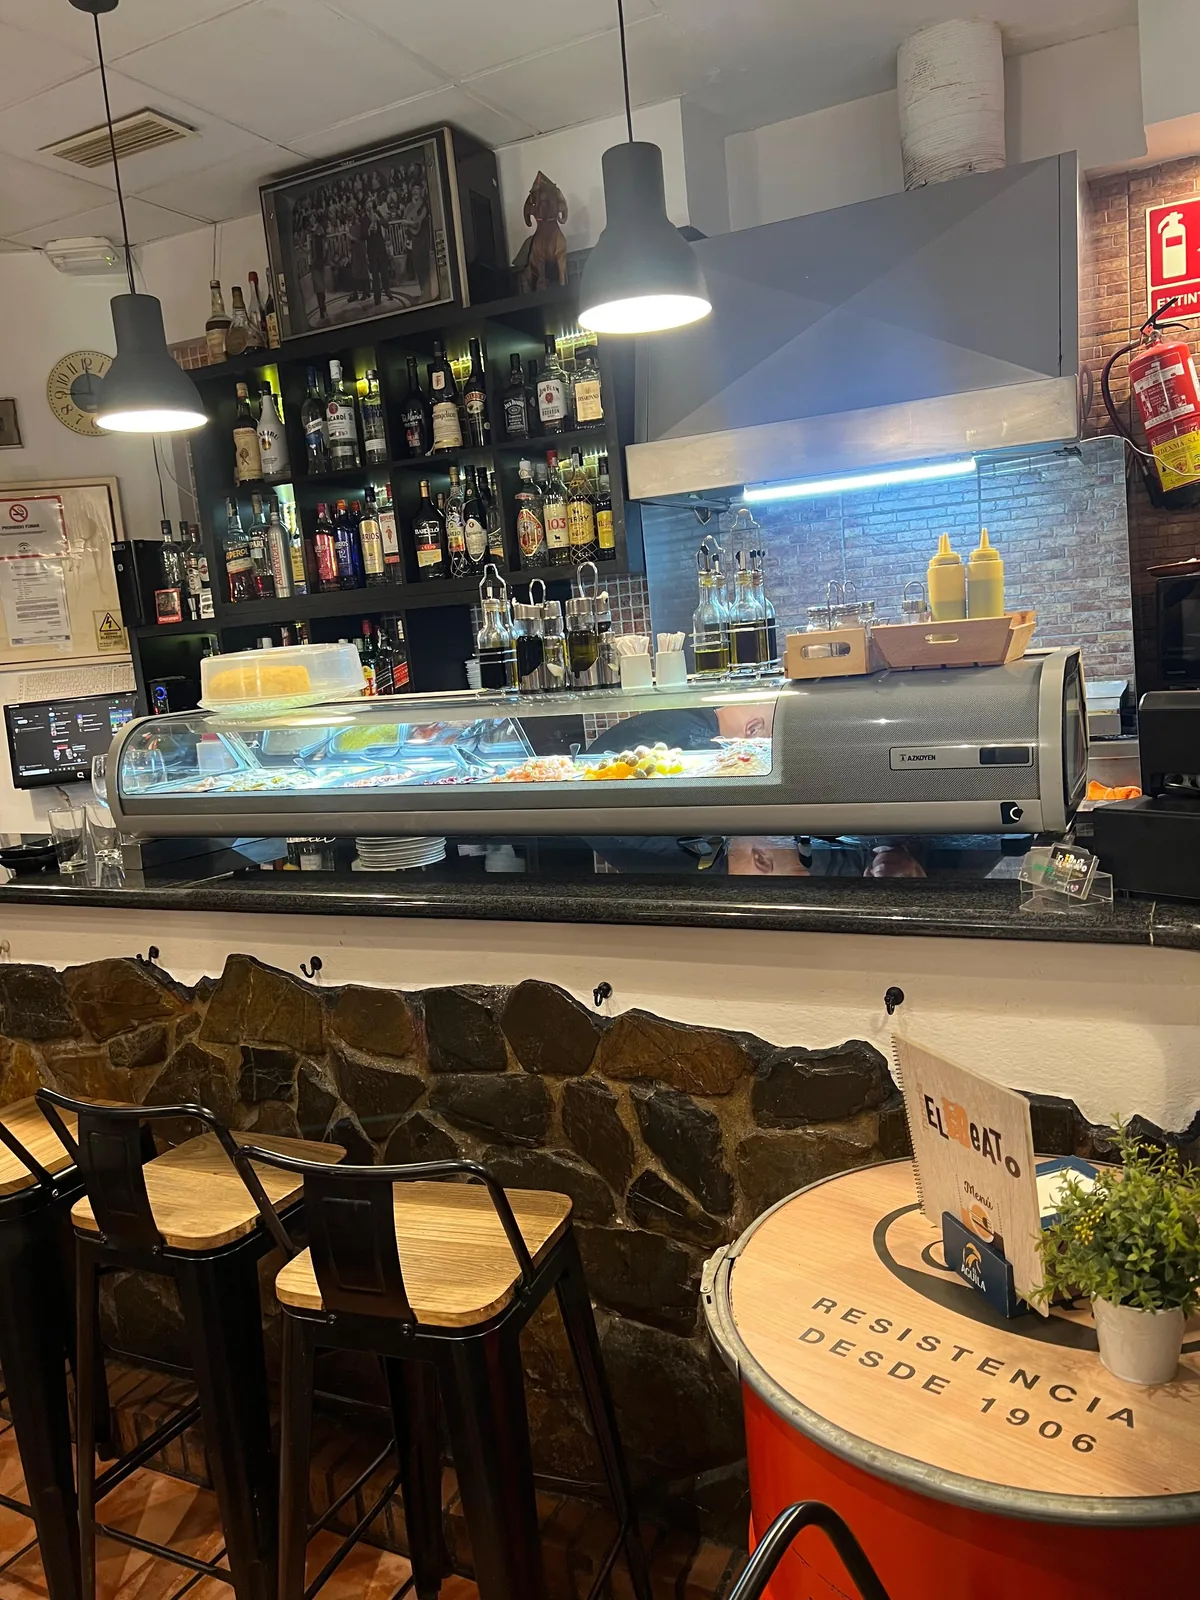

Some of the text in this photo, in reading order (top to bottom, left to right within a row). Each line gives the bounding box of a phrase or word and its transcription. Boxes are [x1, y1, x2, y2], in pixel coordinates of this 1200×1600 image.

[1157, 291, 1200, 311] EXTIN
[547, 518, 566, 531] 103
[798, 1327, 1097, 1453] DESDE 1906
[811, 1296, 1136, 1429] RESISTENCIA
